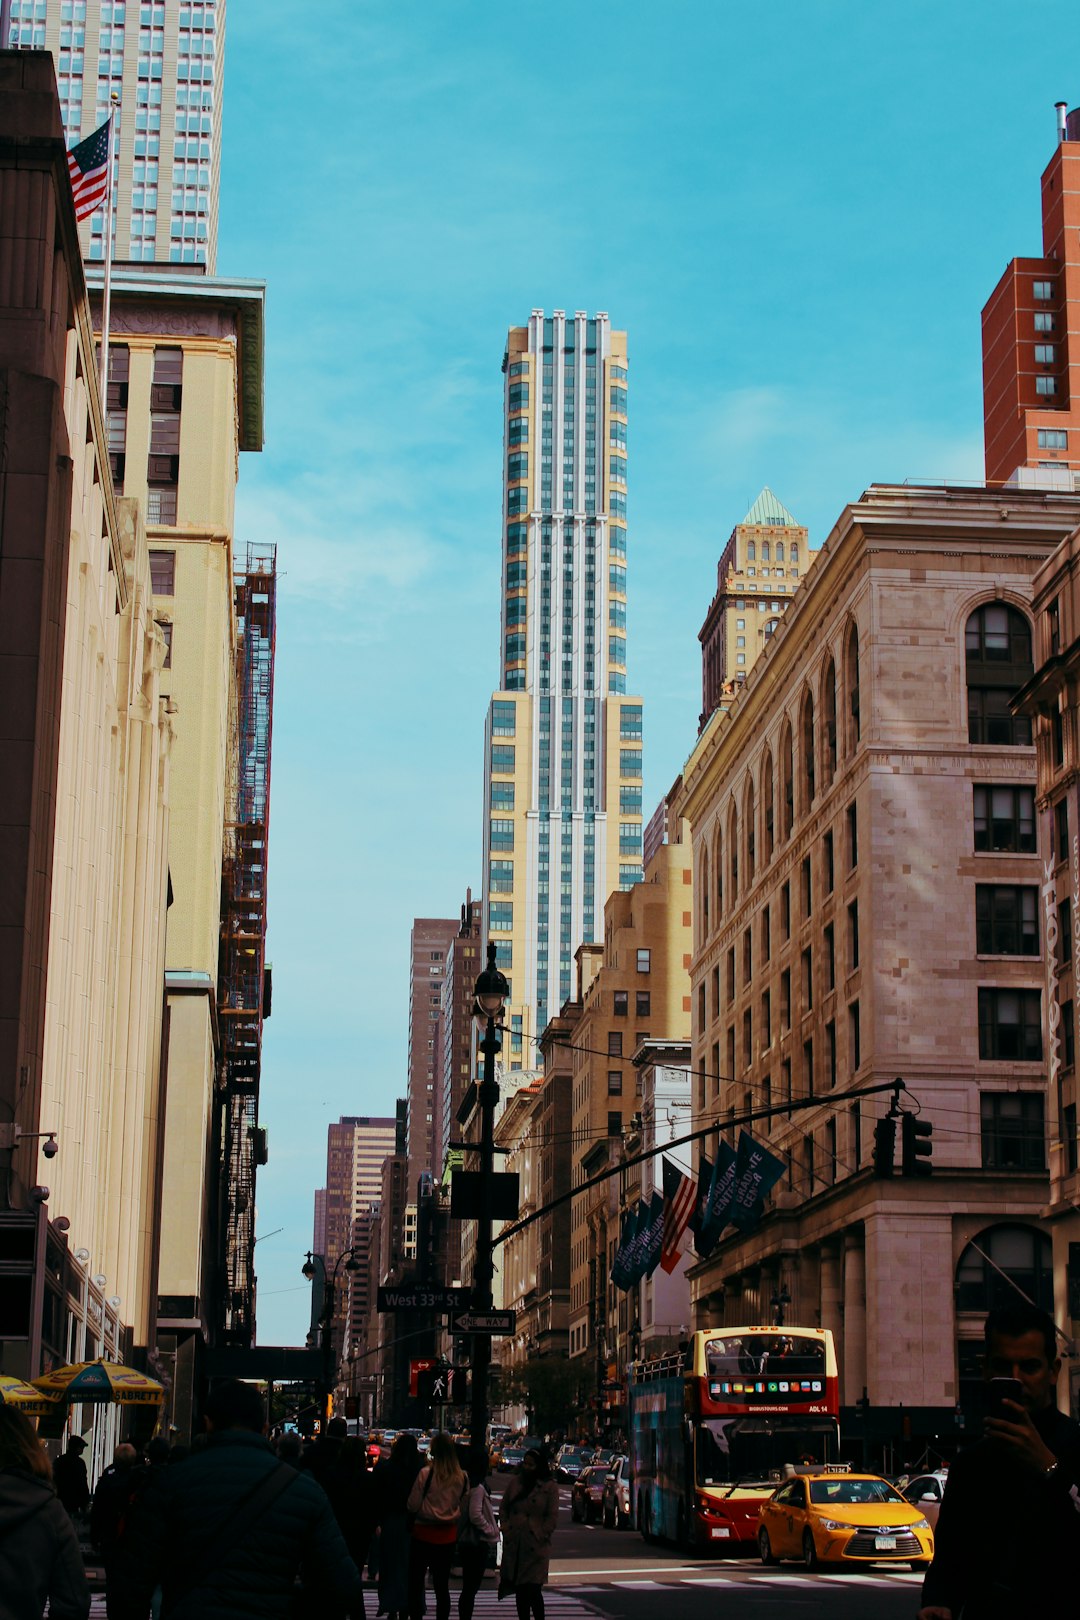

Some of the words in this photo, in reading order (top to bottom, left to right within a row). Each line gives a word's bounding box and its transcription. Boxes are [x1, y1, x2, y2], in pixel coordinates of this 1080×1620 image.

[1041, 851, 1061, 1084] wework
[385, 1293, 417, 1307] West
[420, 1293, 443, 1307] 33rd
[446, 1293, 460, 1307] St
[461, 1317, 477, 1326] ONE
[485, 1317, 504, 1326] WAY
[115, 1391, 160, 1401] SABRETT
[821, 1405, 828, 1413] 14
